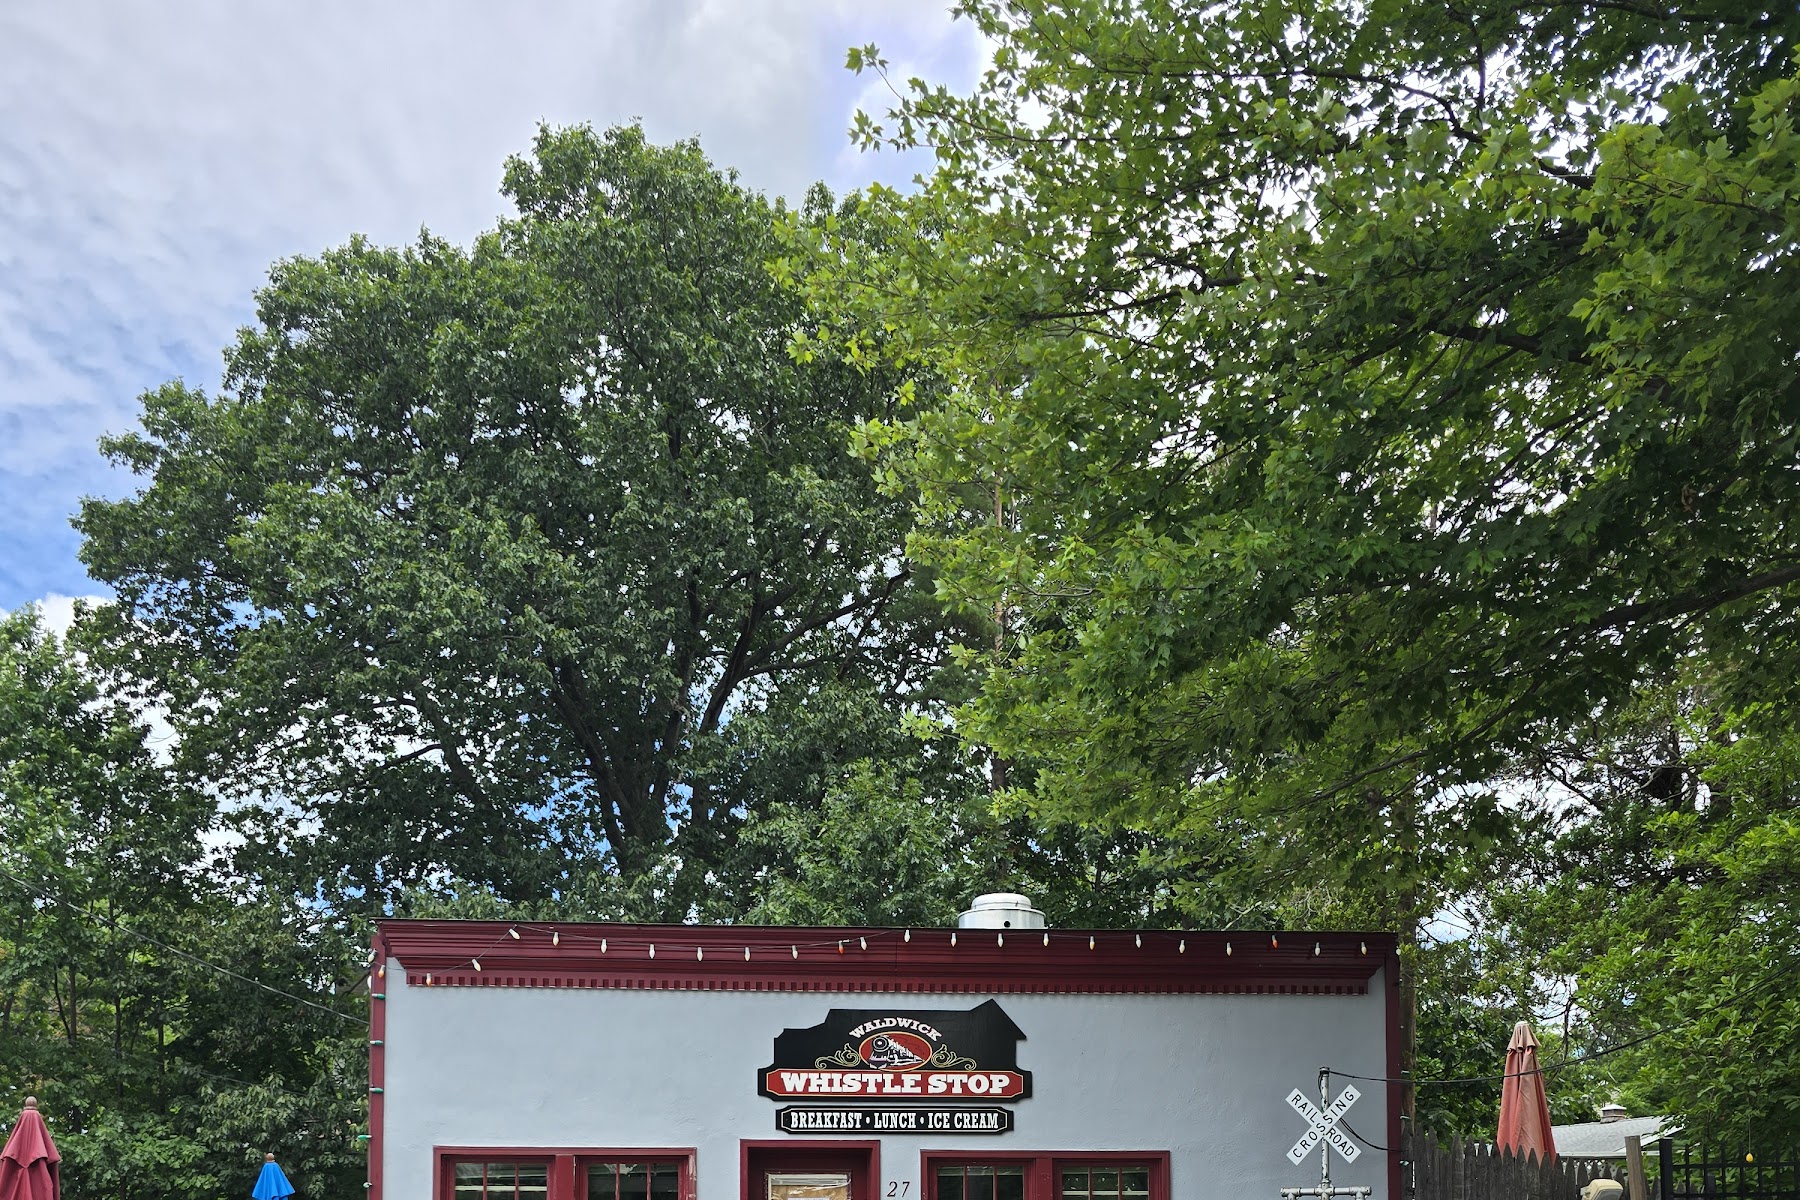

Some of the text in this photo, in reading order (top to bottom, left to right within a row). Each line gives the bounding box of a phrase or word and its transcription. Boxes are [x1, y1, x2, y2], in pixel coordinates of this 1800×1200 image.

[849, 1016, 942, 1042] WALDWICK
[780, 1072, 1010, 1094] WHISTLE STOP
[790, 1111, 999, 1129] BREAKFAST LUNCH ICE CREAM
[1292, 1091, 1354, 1158] CROSSING
[887, 1181, 910, 1198] 27
